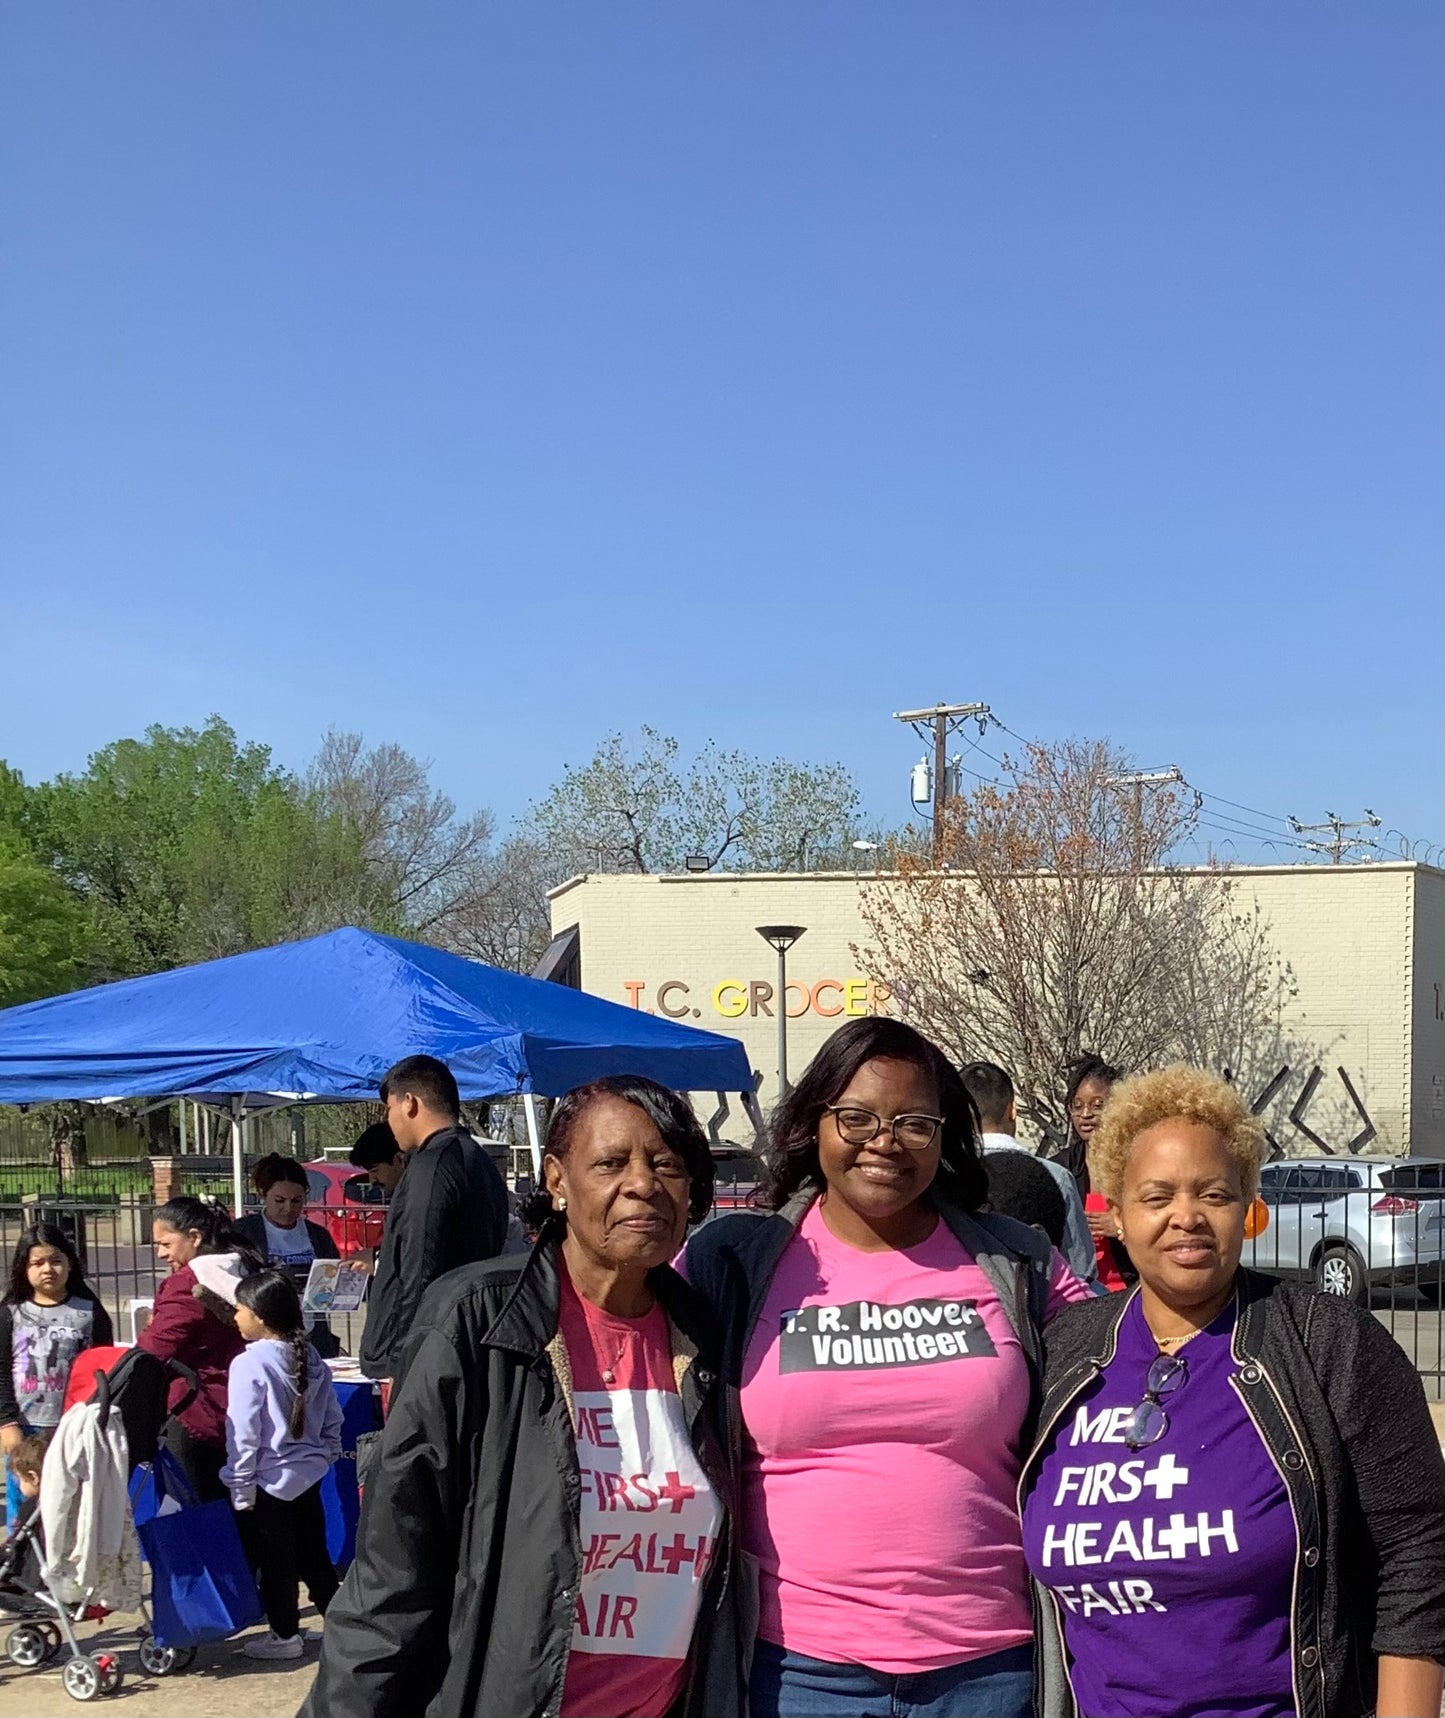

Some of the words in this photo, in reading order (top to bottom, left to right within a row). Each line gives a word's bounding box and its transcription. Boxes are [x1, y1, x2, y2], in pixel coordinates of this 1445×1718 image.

[624, 980, 701, 1018] T.C.
[781, 1309, 807, 1334] T.
[818, 1306, 850, 1332] R.
[860, 1301, 977, 1331] Hoover
[812, 1329, 969, 1365] Volunteer
[1069, 1406, 1135, 1446] ME
[573, 1593, 638, 1639] AIR
[1053, 1579, 1167, 1617] FAIR
